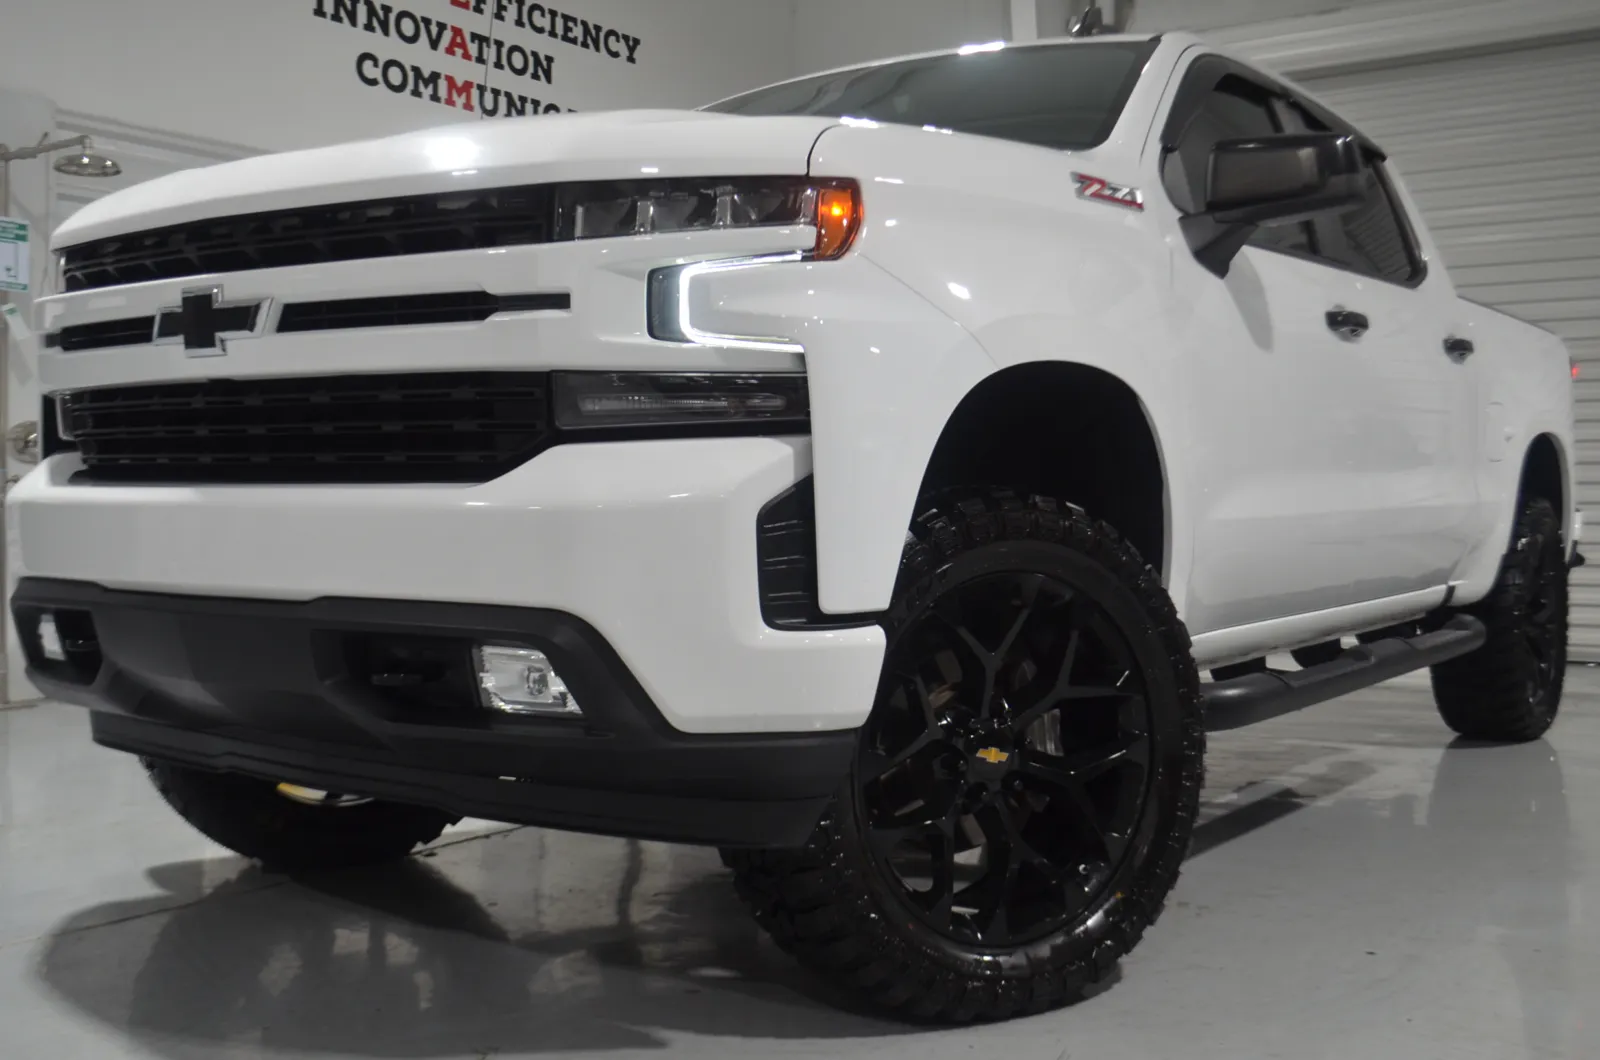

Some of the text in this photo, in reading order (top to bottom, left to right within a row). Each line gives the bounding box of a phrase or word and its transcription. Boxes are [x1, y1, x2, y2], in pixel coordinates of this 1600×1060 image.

[313, 0, 554, 84] INNOVATION
[449, 0, 641, 64] FICIENCY
[356, 52, 578, 117] COMMUNI
[1070, 171, 1144, 212] Z71
